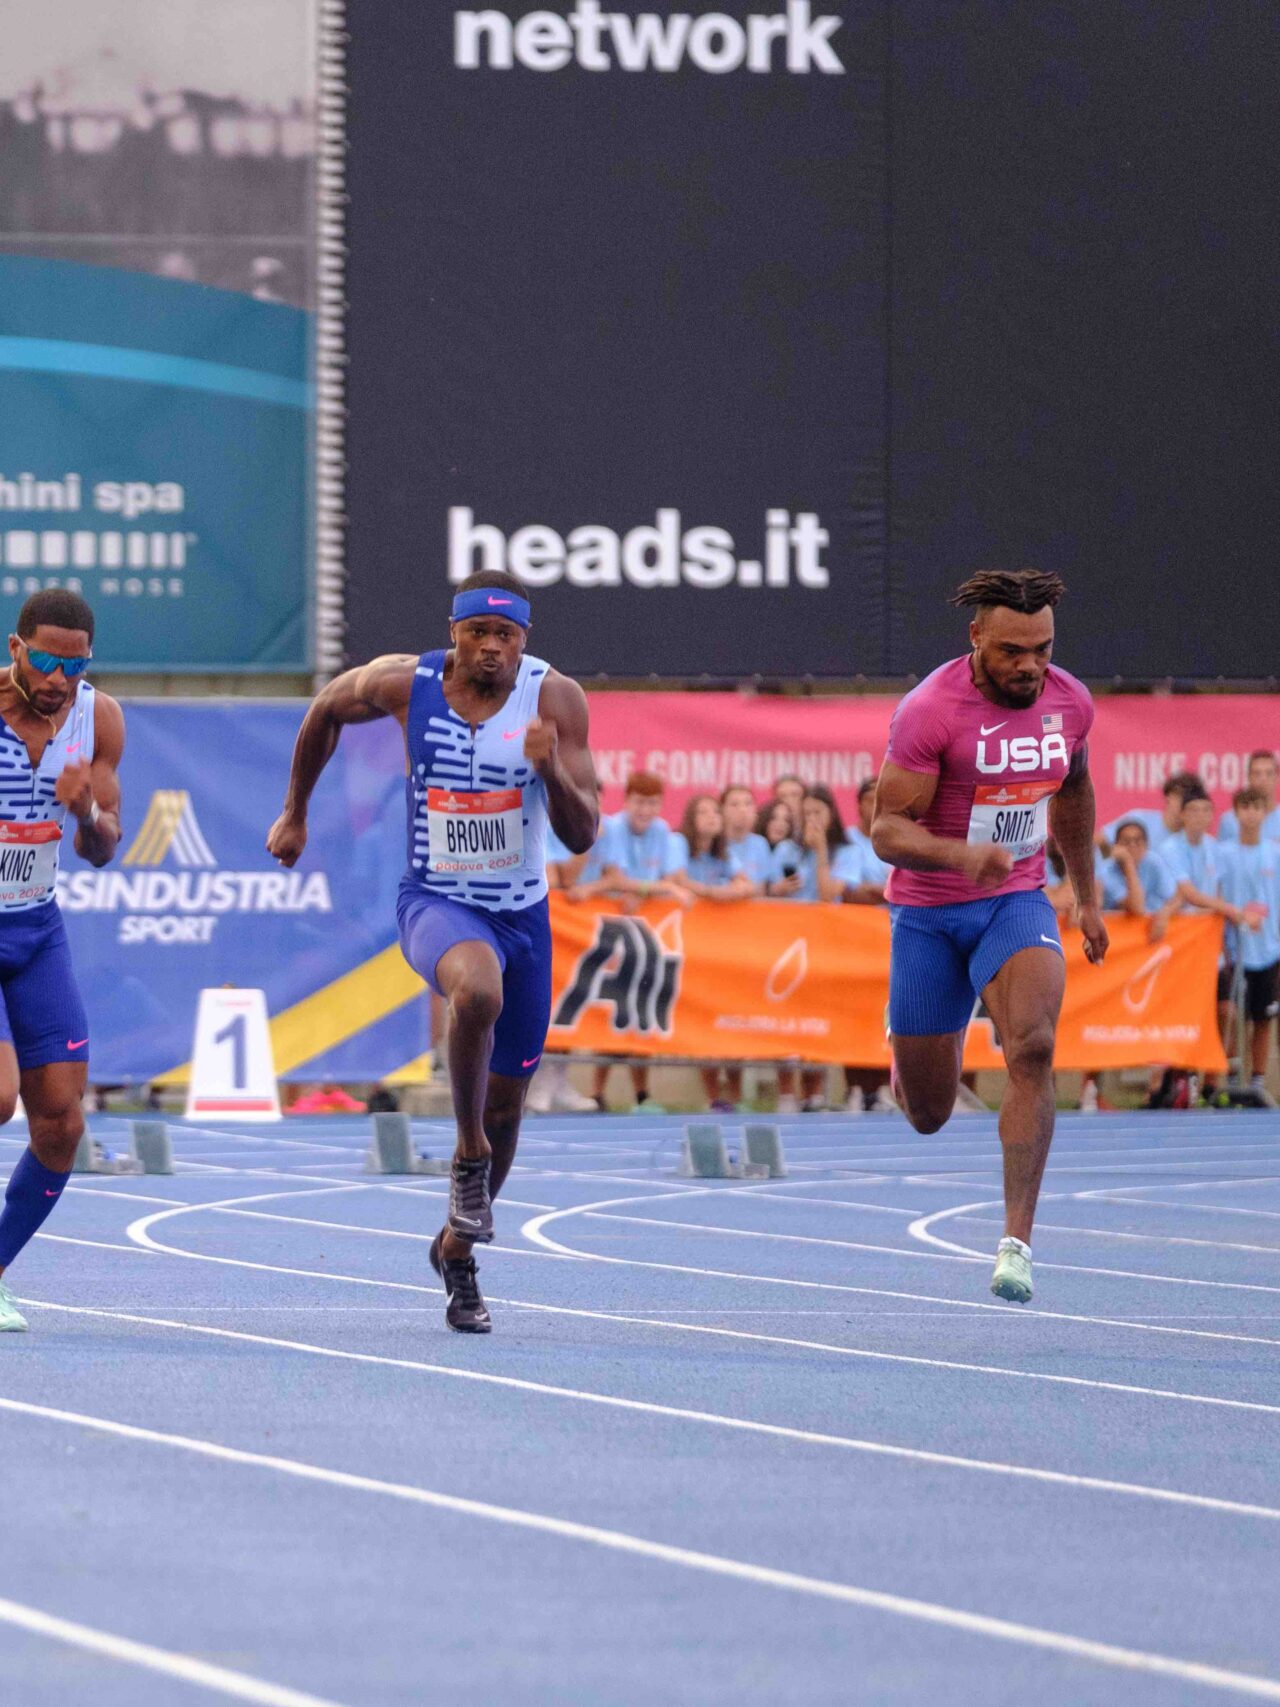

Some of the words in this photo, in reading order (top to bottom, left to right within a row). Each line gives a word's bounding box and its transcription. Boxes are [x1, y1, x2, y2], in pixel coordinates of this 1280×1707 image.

[453, 0, 846, 74] network
[95, 480, 186, 519] spa
[447, 505, 830, 588] heads.it
[975, 733, 1068, 774] USA
[446, 818, 506, 853] BROWN
[992, 806, 1038, 843] SMITH
[435, 861, 483, 873] padova
[488, 853, 519, 869] 2023
[57, 871, 333, 912] SSINDUSTRIA
[118, 915, 218, 944] SPORT
[215, 1014, 248, 1089] 1
